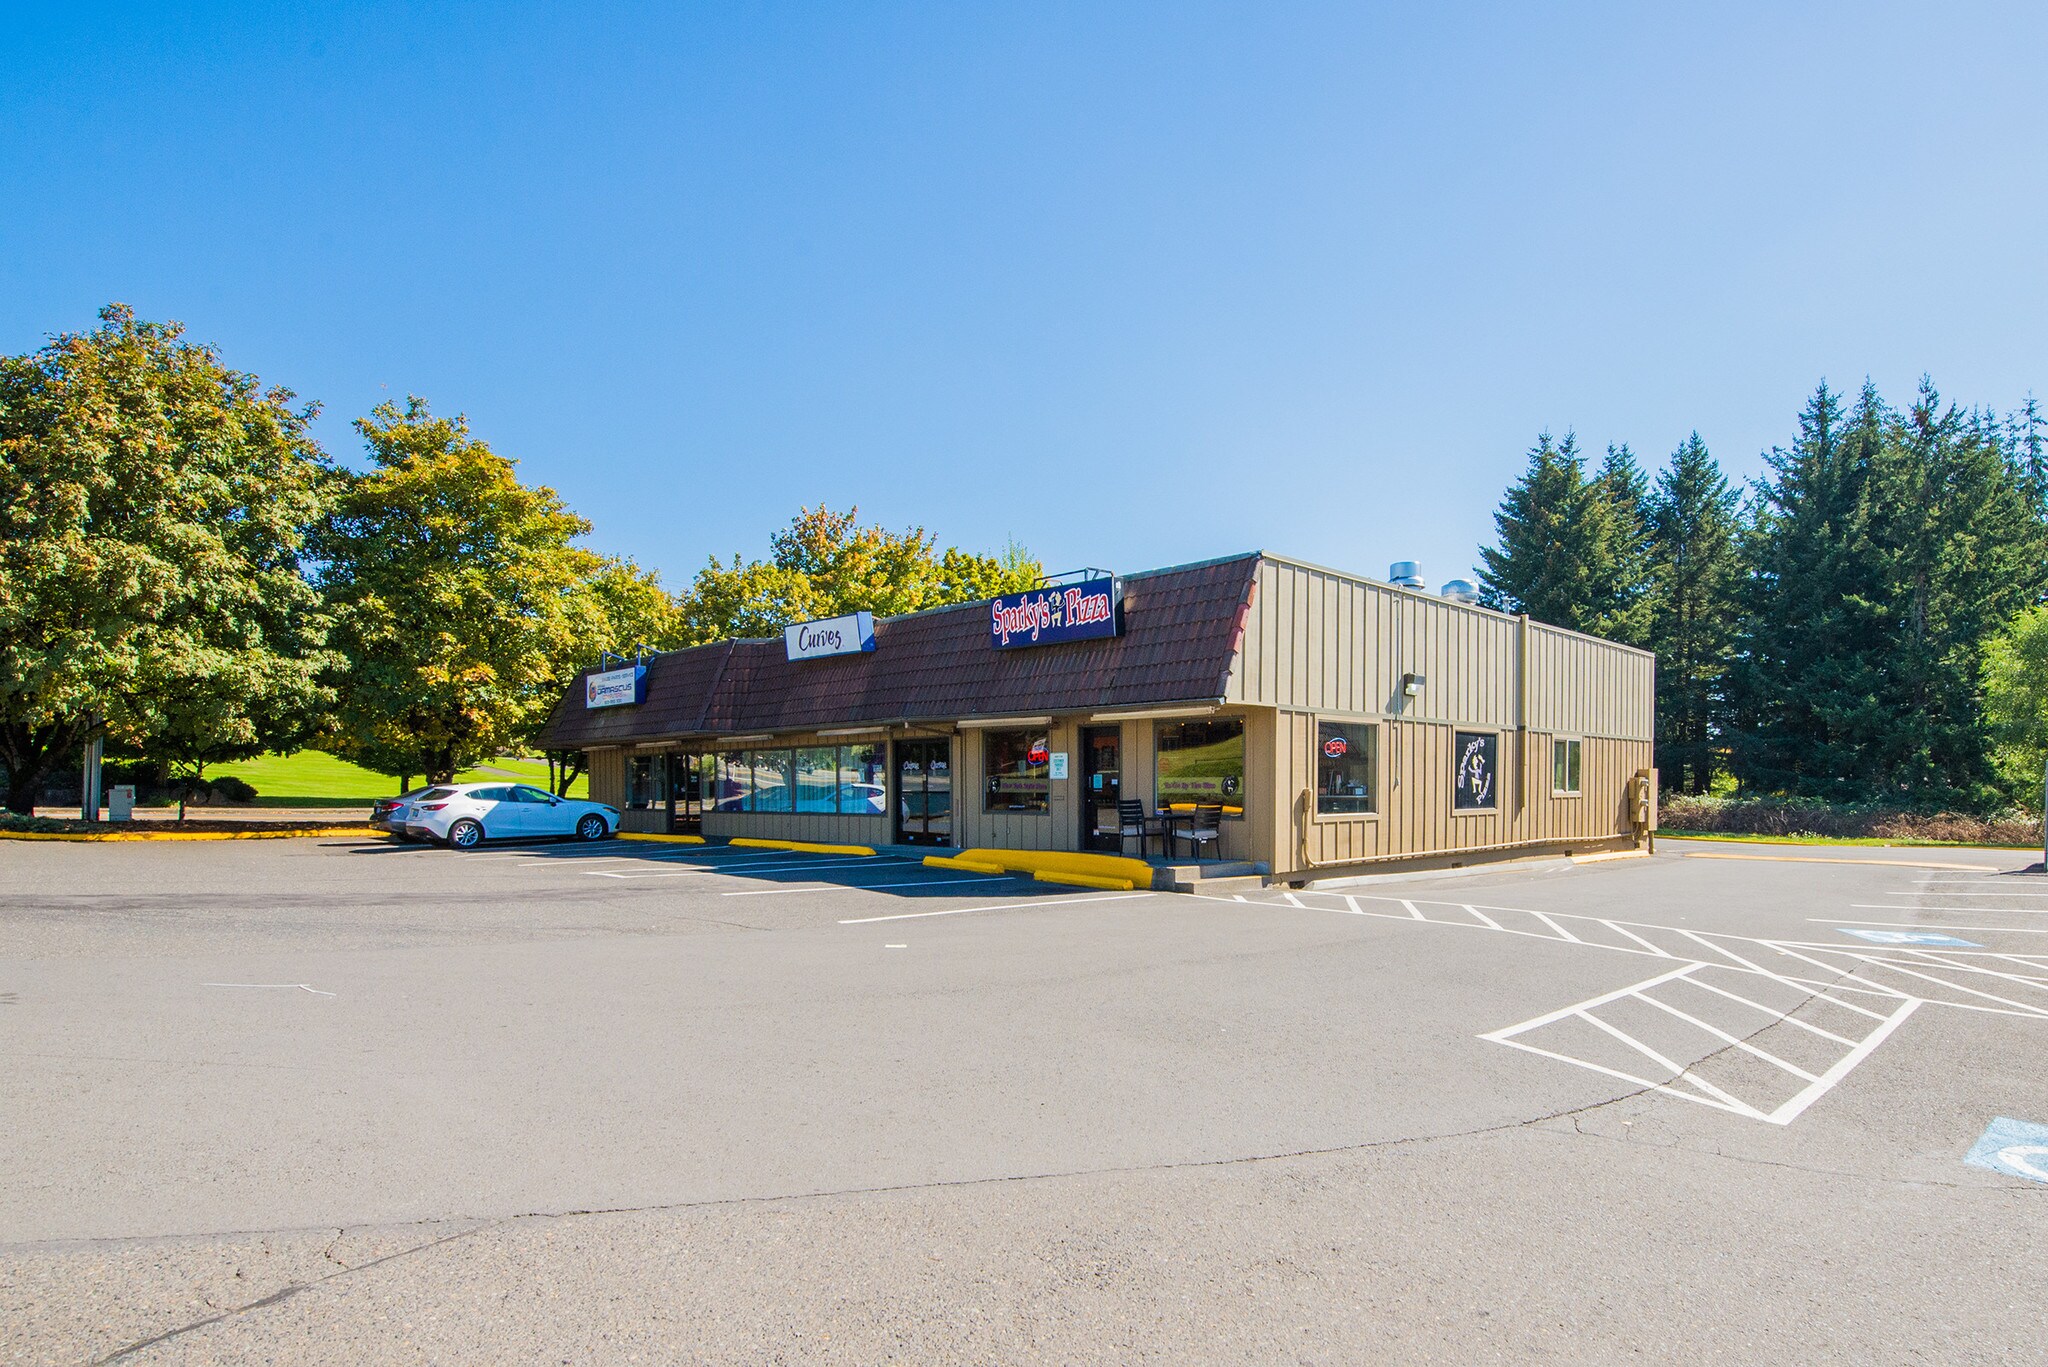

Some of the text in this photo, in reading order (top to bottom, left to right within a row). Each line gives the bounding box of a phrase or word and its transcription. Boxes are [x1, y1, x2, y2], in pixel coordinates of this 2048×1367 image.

[993, 587, 1111, 646] Sparky's Pizza
[798, 625, 842, 652] Curves
[597, 683, 632, 695] DAMASCUS
[1027, 750, 1049, 762] OPEN
[1324, 741, 1347, 754] OPEN
[1457, 736, 1485, 789] Sparky's
